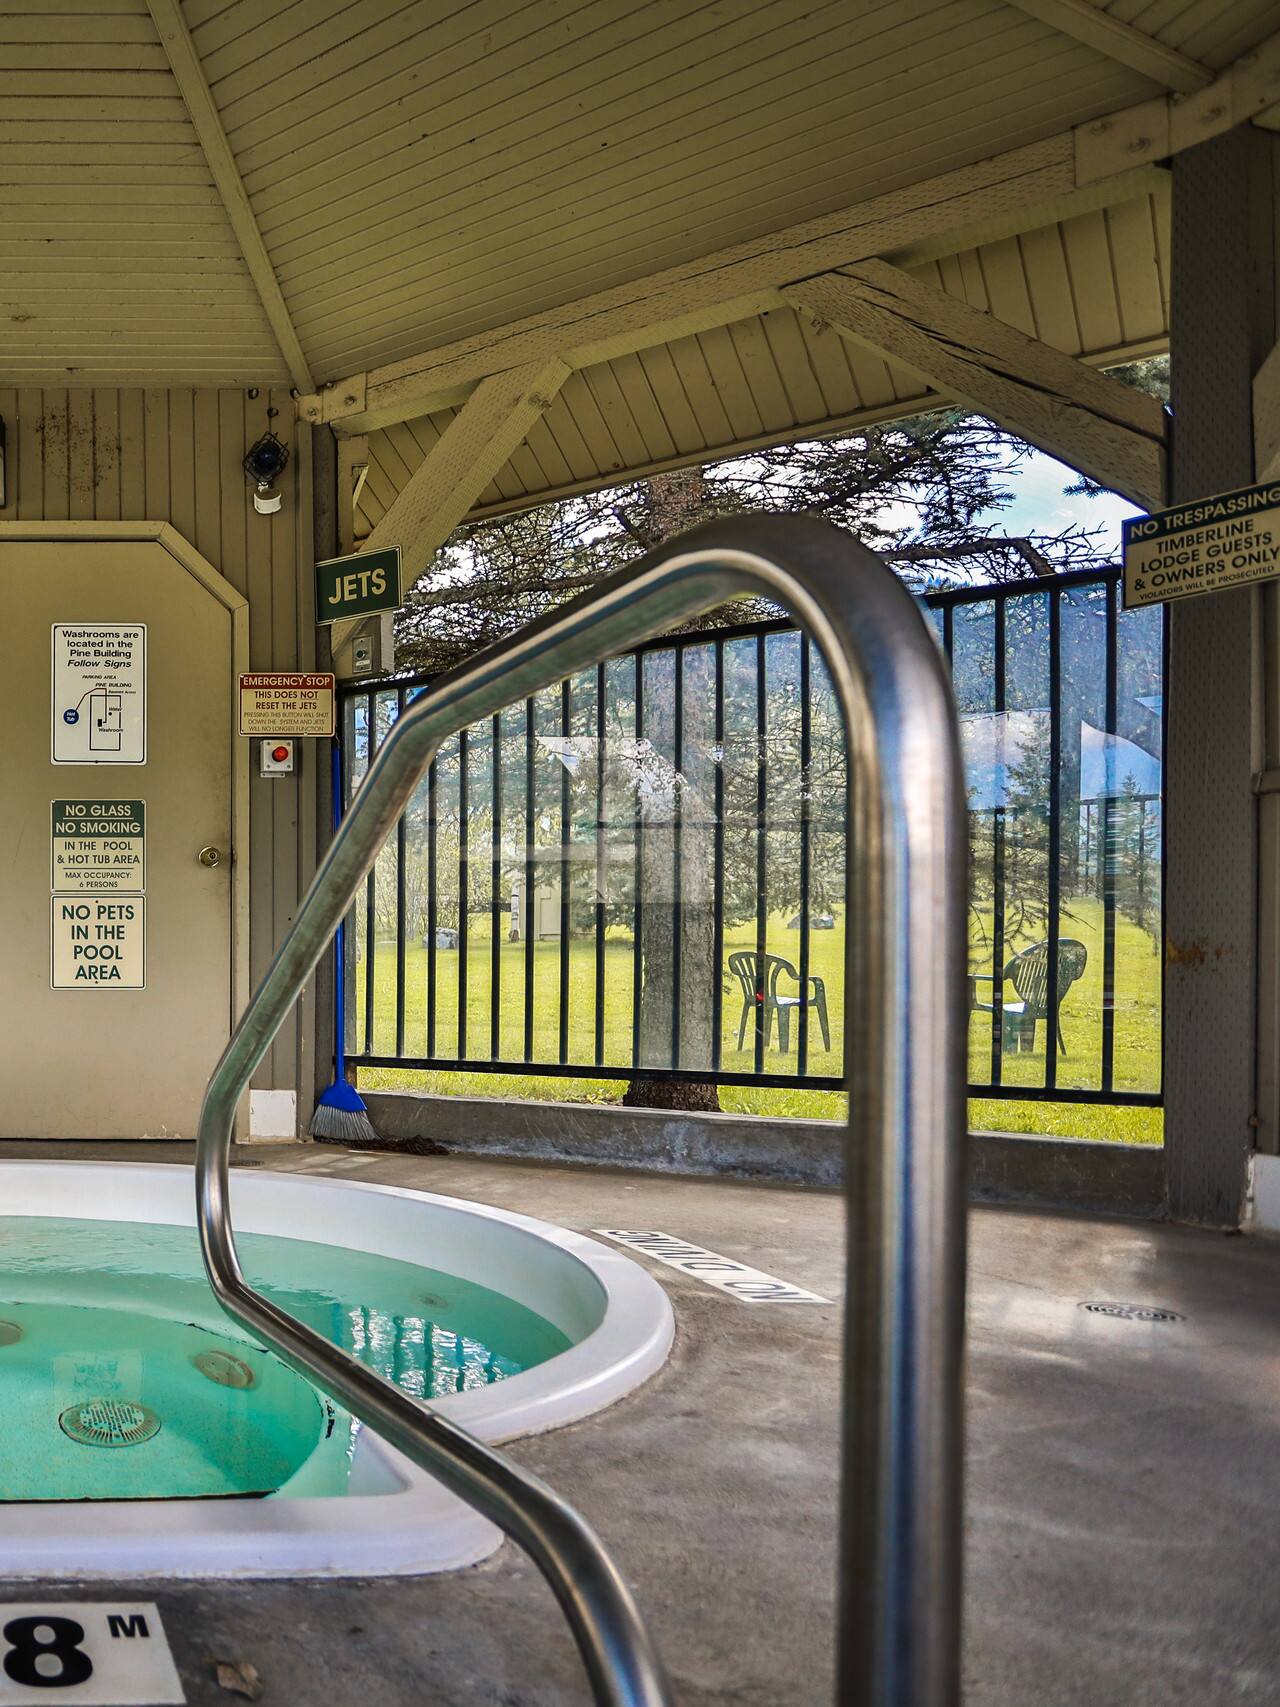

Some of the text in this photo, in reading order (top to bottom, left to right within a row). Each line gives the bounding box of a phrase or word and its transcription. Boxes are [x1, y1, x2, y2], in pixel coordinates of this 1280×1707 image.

[1131, 488, 1280, 538] NO TRESPASSING
[1156, 519, 1254, 554] TIMBERLINE
[1141, 531, 1272, 574] LODGE GUESTS
[1134, 546, 1280, 591] & OWNERS ONLY
[328, 567, 387, 605] JETS
[1139, 564, 1275, 600] VIOLATORS WILL BE PROSECUTED
[62, 630, 120, 639] Washrooms
[67, 640, 133, 648] located in the
[93, 649, 132, 659] Building
[67, 659, 132, 669] Follow Signs
[243, 677, 330, 686] EMERGENCY STOP
[254, 691, 318, 699] THIS DOES NOT
[256, 702, 317, 710] RESET THE JETS
[65, 805, 131, 816] NO GLASS
[55, 822, 141, 833] NO SMOKING
[64, 841, 132, 851] IN THE POOL
[57, 855, 140, 864] & HOT TUB AREA
[62, 905, 135, 920] NO PETS
[71, 925, 125, 940] IN THE
[73, 945, 123, 960] POOL
[75, 965, 121, 980] AREA
[607, 1230, 747, 1272] DIVING
[724, 1281, 814, 1300] NO
[107, 1614, 150, 1638] M
